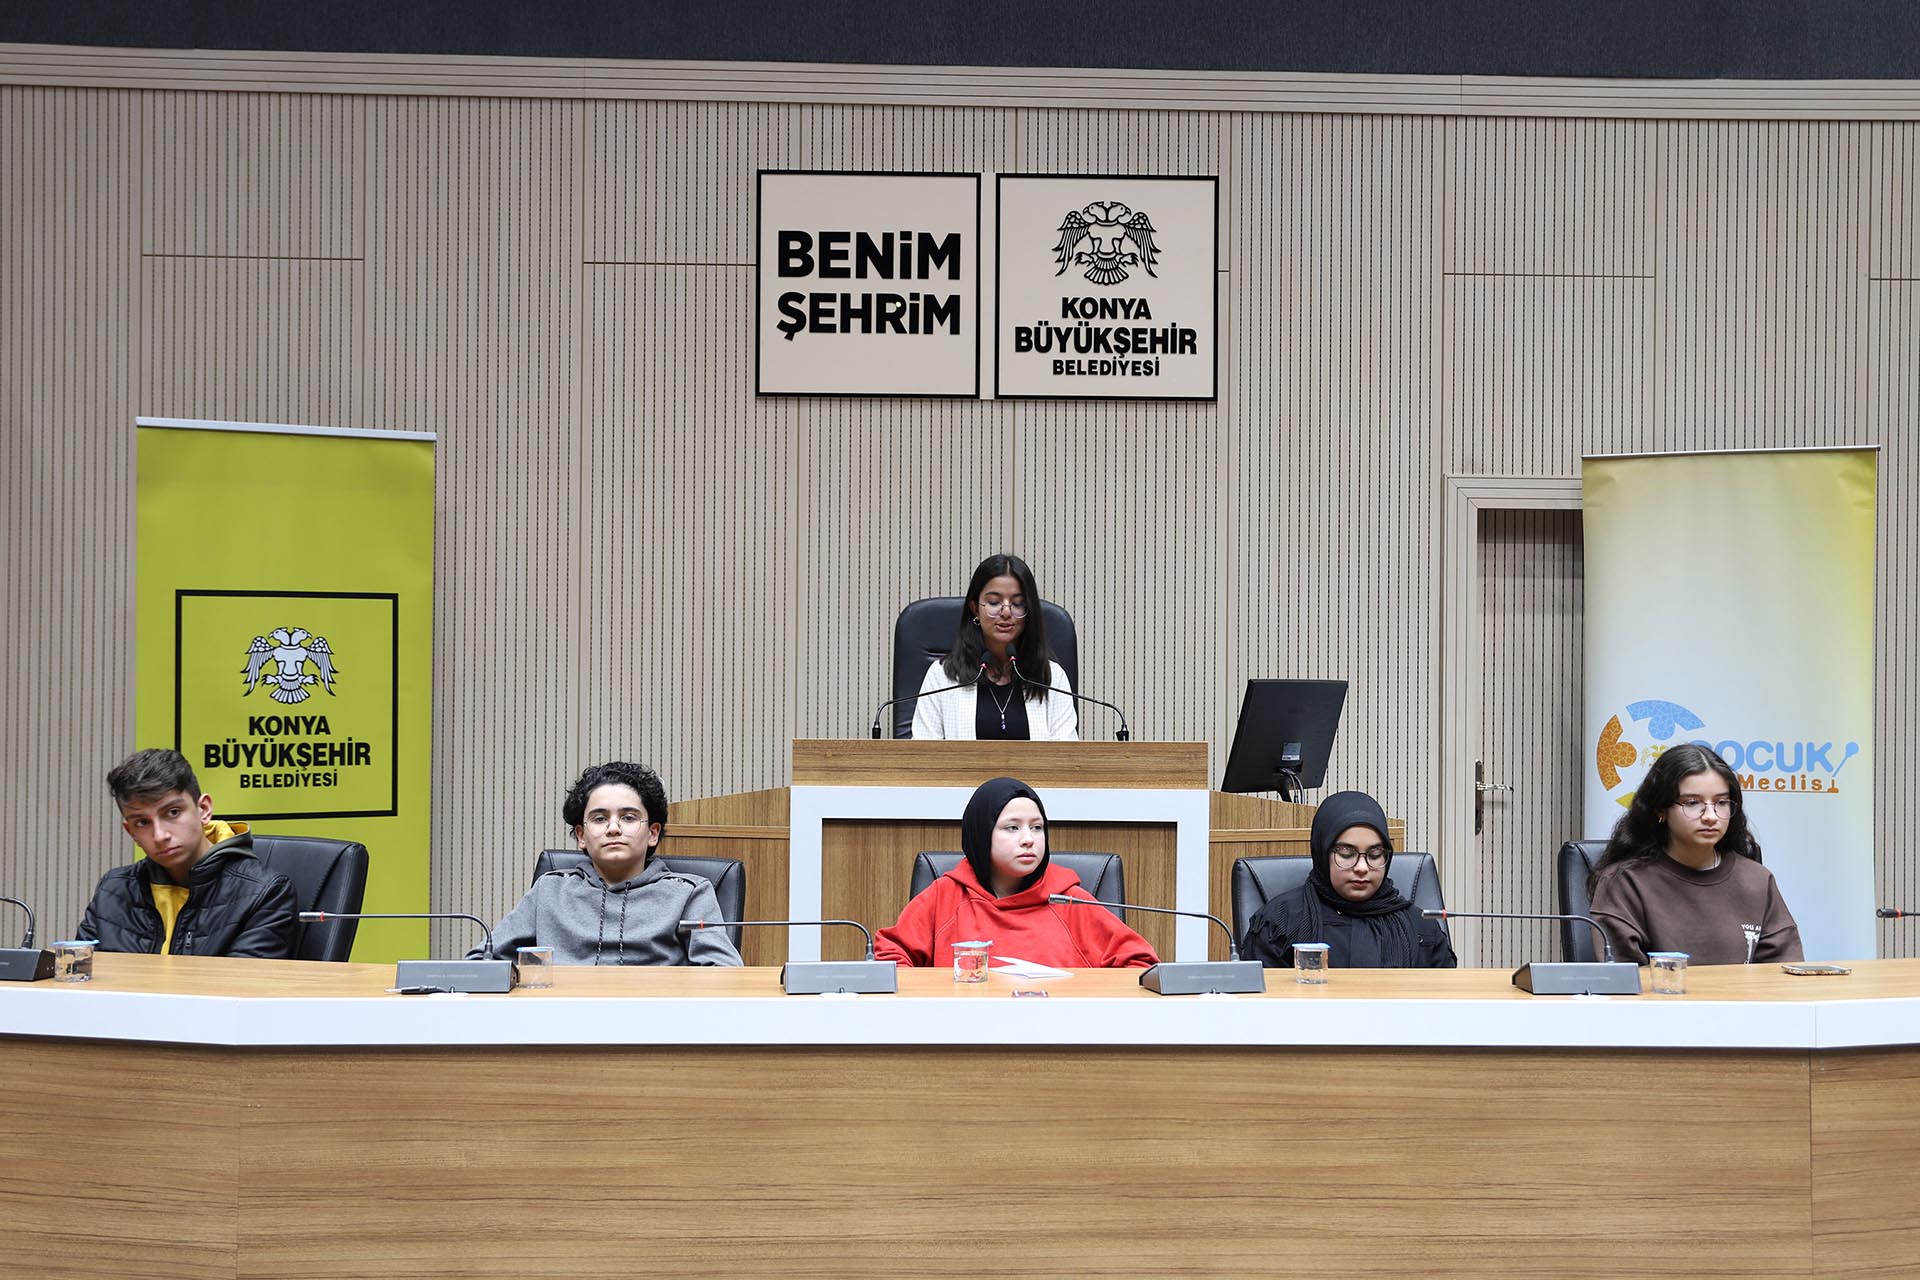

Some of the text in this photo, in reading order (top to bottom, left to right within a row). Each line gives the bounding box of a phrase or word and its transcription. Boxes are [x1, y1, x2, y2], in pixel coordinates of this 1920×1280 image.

[1061, 296, 1153, 320] KONYA
[1014, 321, 1197, 359] BÜYÜKŞEHİR
[1052, 356, 1160, 377] BELEDİYESİ
[248, 715, 332, 736] KONYA
[204, 737, 371, 770] BÜYÜKŞEHİR
[1690, 740, 1834, 773] OCUK
[240, 769, 338, 789] BELEDİYESİ
